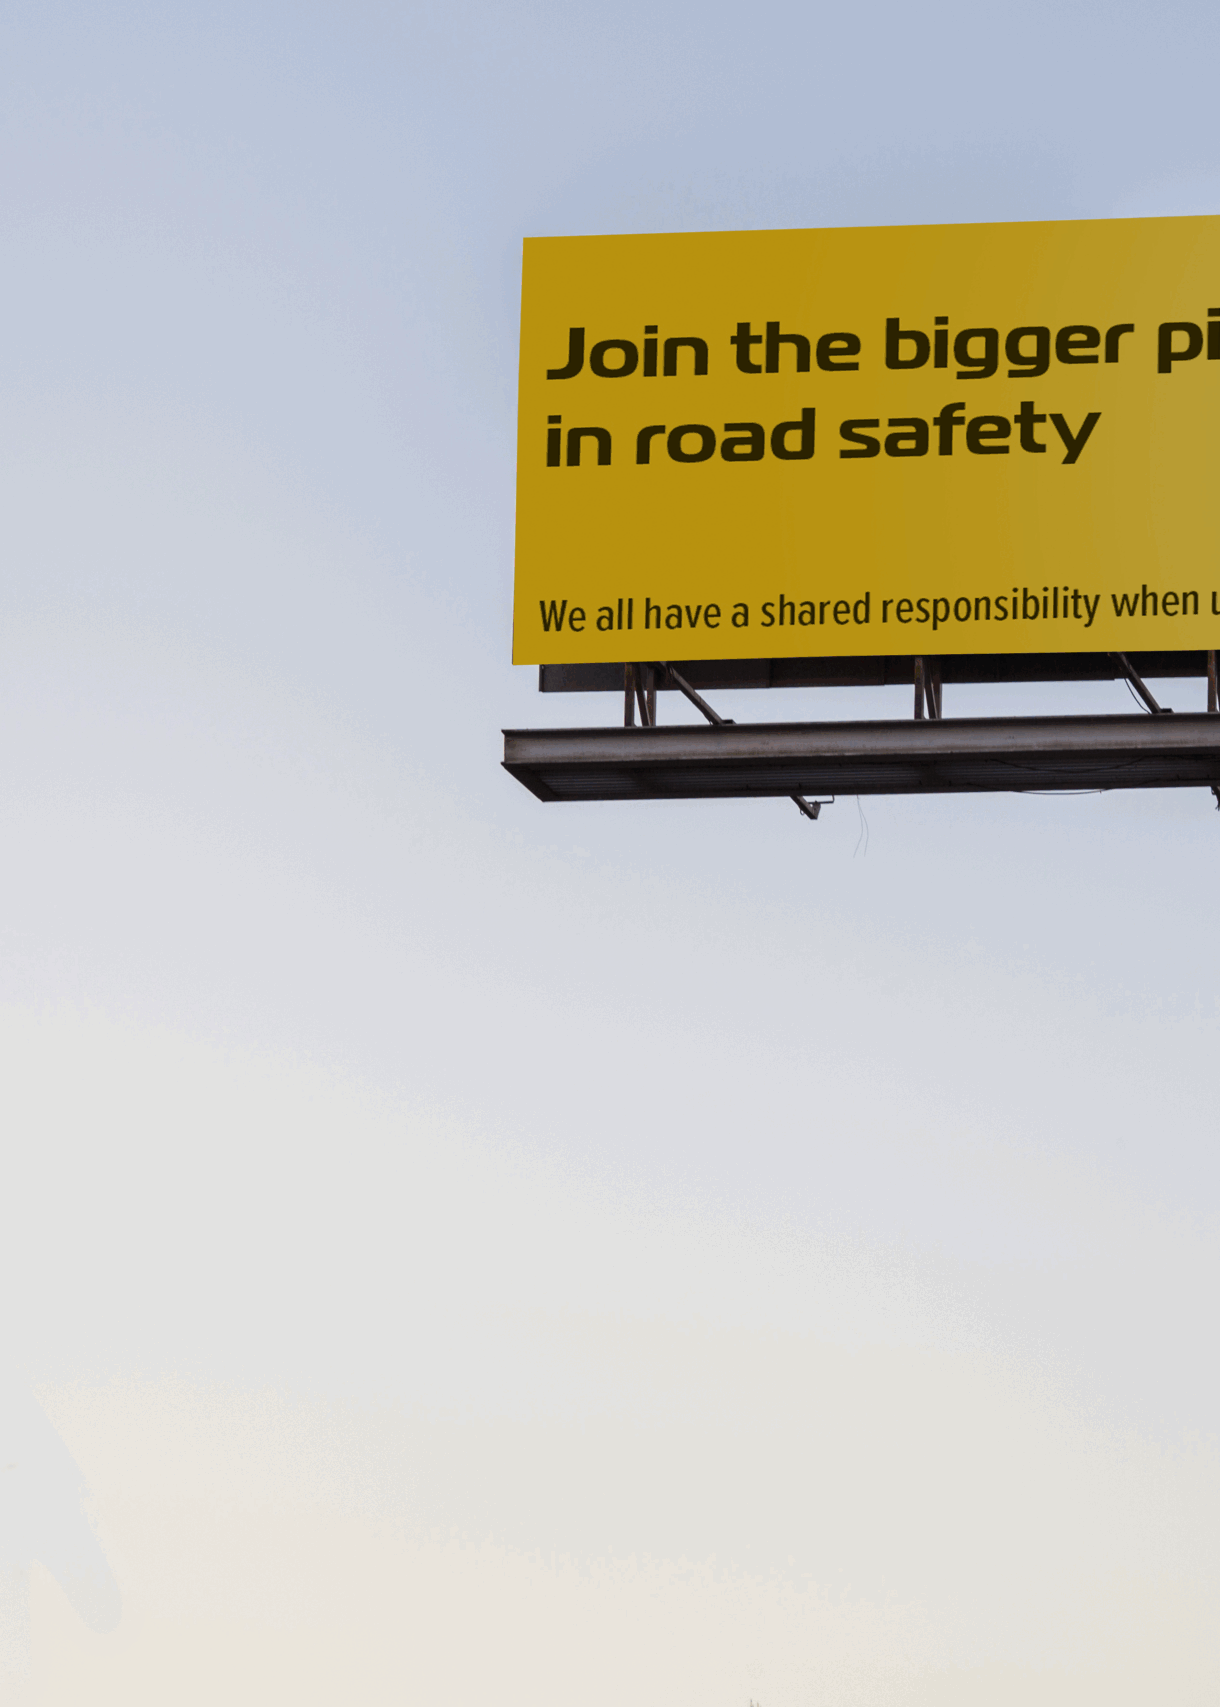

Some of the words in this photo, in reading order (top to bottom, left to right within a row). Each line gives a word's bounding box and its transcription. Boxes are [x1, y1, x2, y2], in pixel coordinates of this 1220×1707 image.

[547, 325, 708, 380] Join
[731, 322, 861, 374] the
[886, 316, 1134, 379] bigger
[547, 415, 611, 467] in
[636, 408, 815, 464] road
[840, 401, 1101, 464] safety
[540, 600, 585, 632] We
[597, 598, 633, 631] all
[645, 598, 721, 629] have
[732, 603, 748, 627] a
[761, 592, 870, 627] shared
[883, 586, 1100, 630] responsibility
[1111, 585, 1198, 616] when
